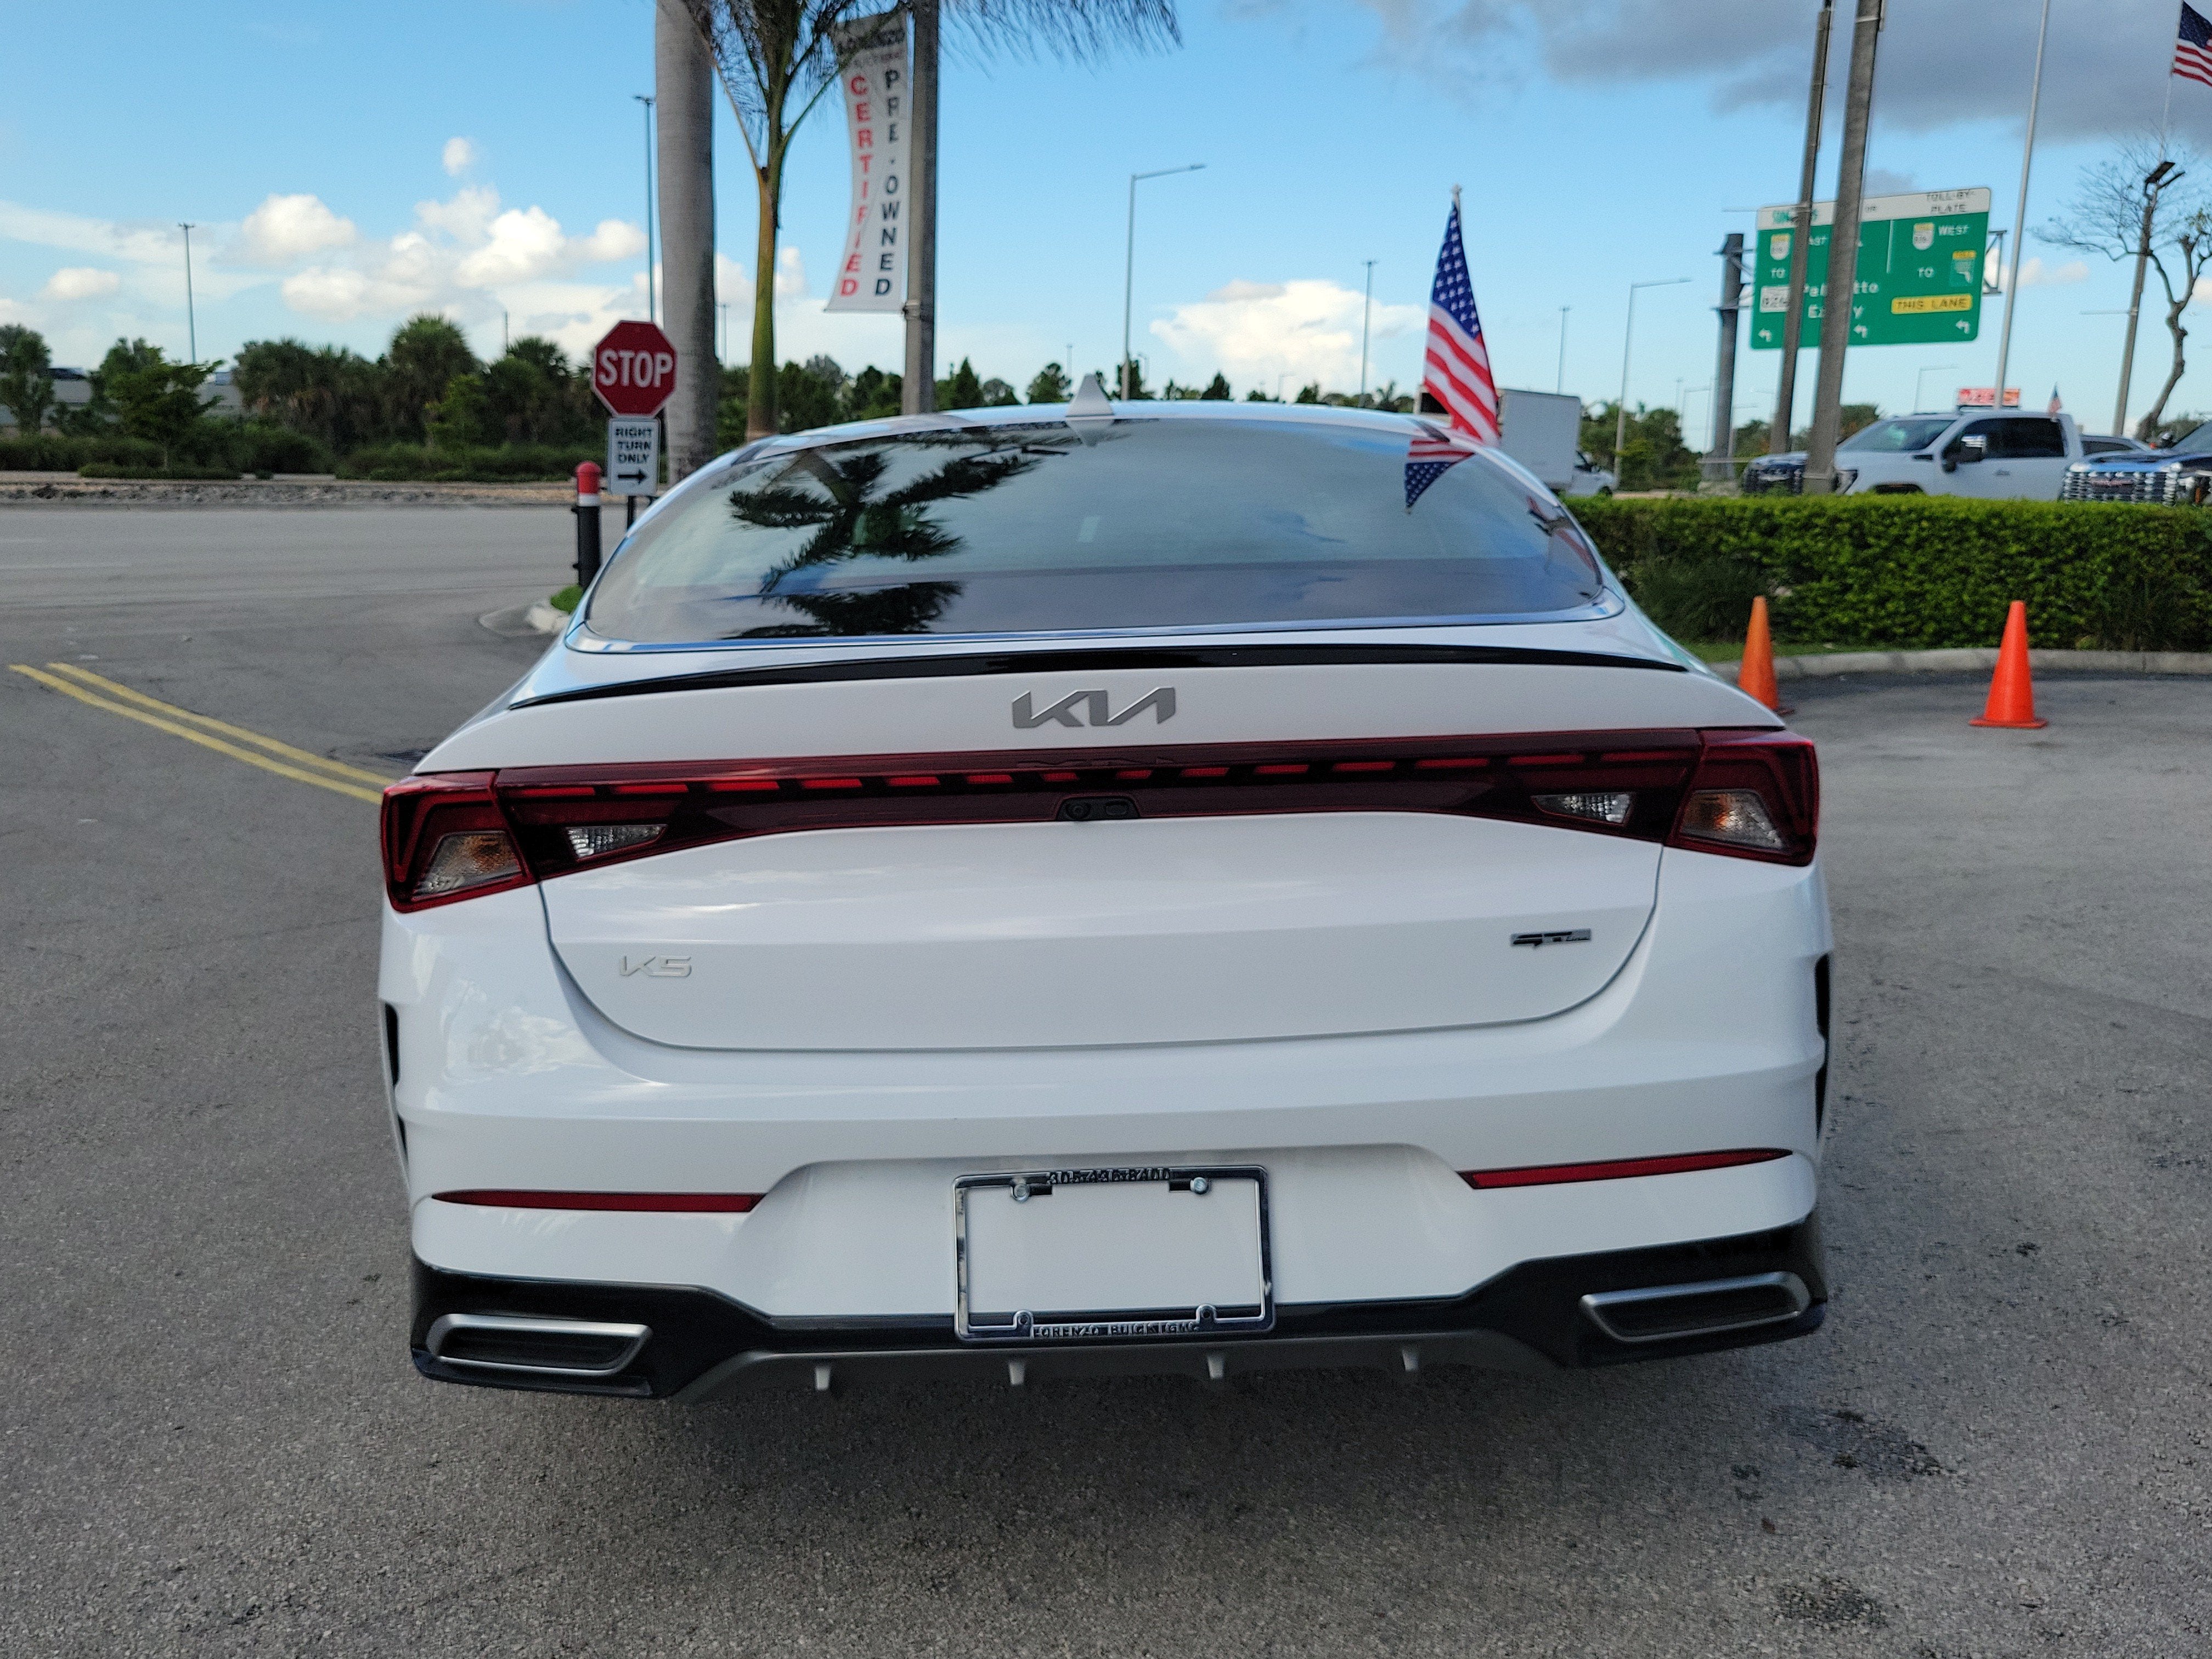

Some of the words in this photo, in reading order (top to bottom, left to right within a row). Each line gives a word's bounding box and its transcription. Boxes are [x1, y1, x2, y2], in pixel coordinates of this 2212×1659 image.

[840, 75, 873, 297] CERTIFIED
[1930, 204, 1969, 214] PLATE
[1938, 223, 1970, 236] WEST
[1771, 267, 1786, 279] TO
[1917, 267, 1934, 278] TO
[1897, 301, 1924, 310] THIS
[1931, 298, 1967, 308] LANE
[597, 348, 673, 388] STOP
[615, 427, 653, 437] RIGHT
[617, 441, 652, 451] TURN
[617, 453, 650, 464] ONLY
[1012, 687, 1176, 729] KIA
[619, 955, 692, 978] K5
